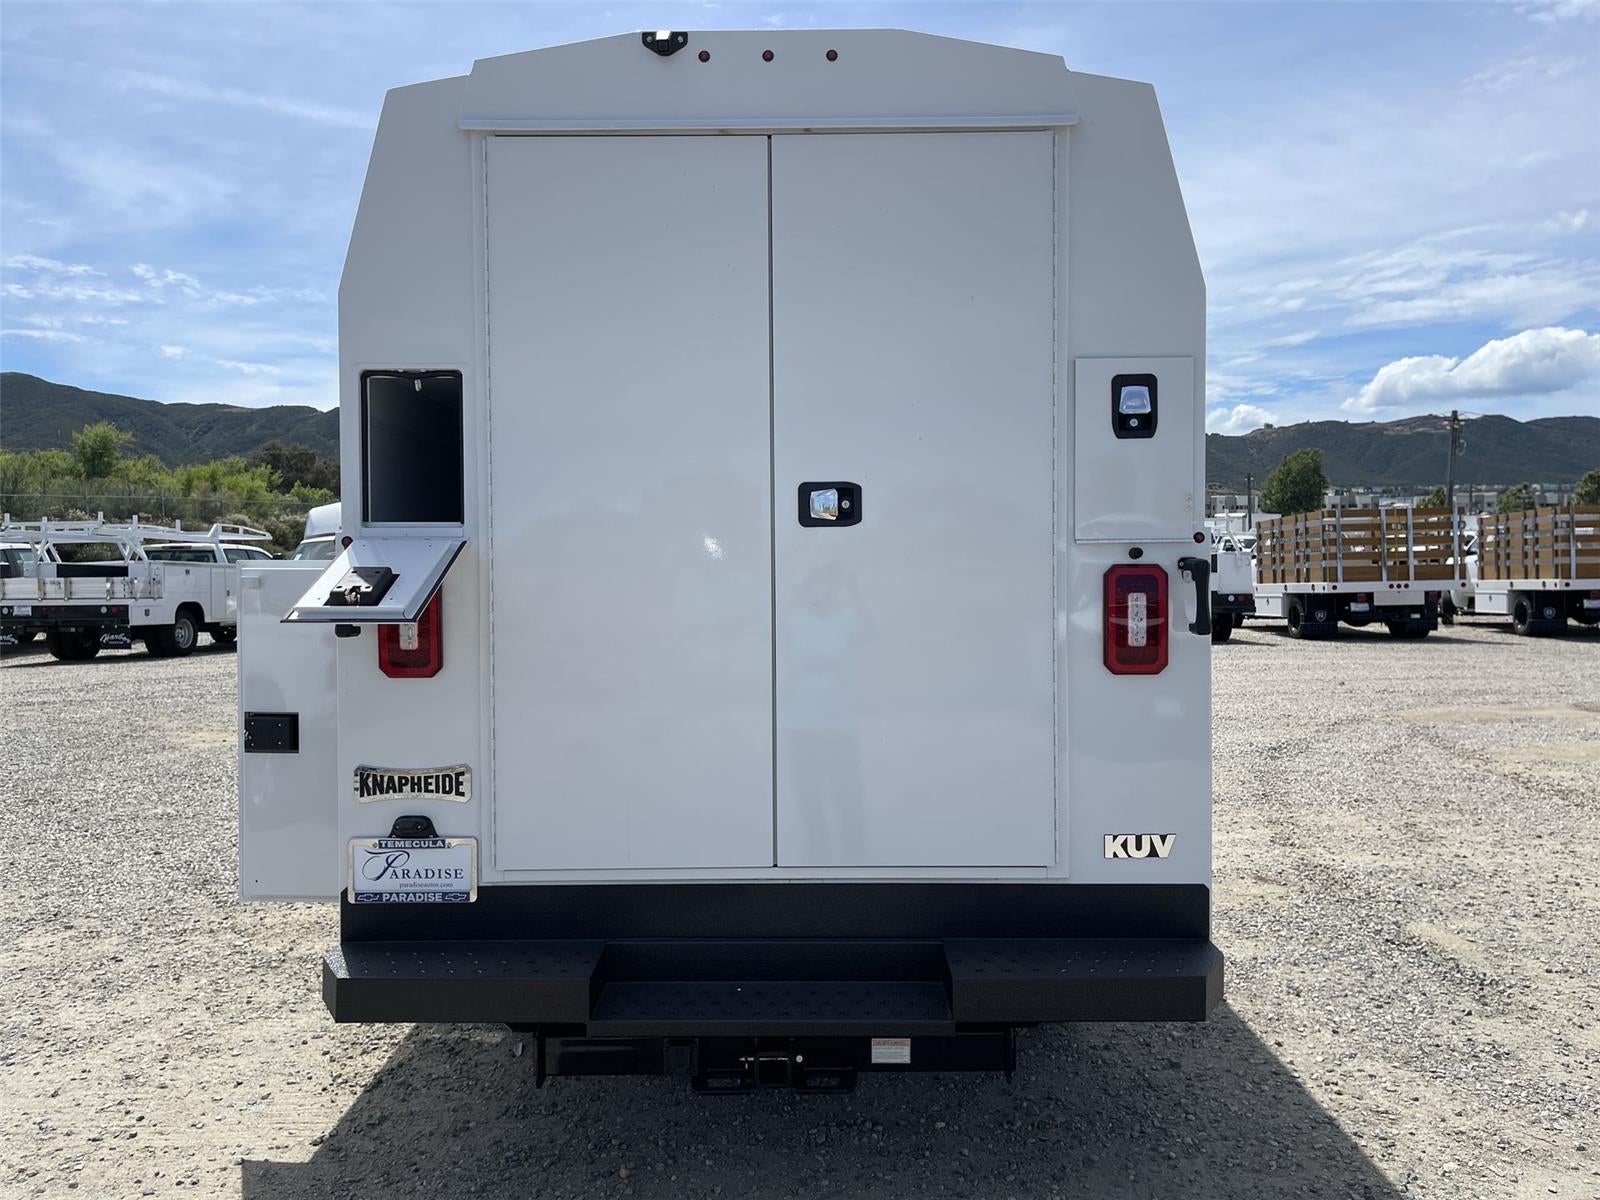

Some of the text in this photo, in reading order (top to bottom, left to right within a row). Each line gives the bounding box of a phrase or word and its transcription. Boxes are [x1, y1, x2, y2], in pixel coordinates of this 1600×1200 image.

[359, 771, 465, 797] KNAPHEIDE
[380, 840, 444, 848] TEMECULA
[1104, 833, 1176, 859] KUV
[382, 893, 443, 902] PARADISE
